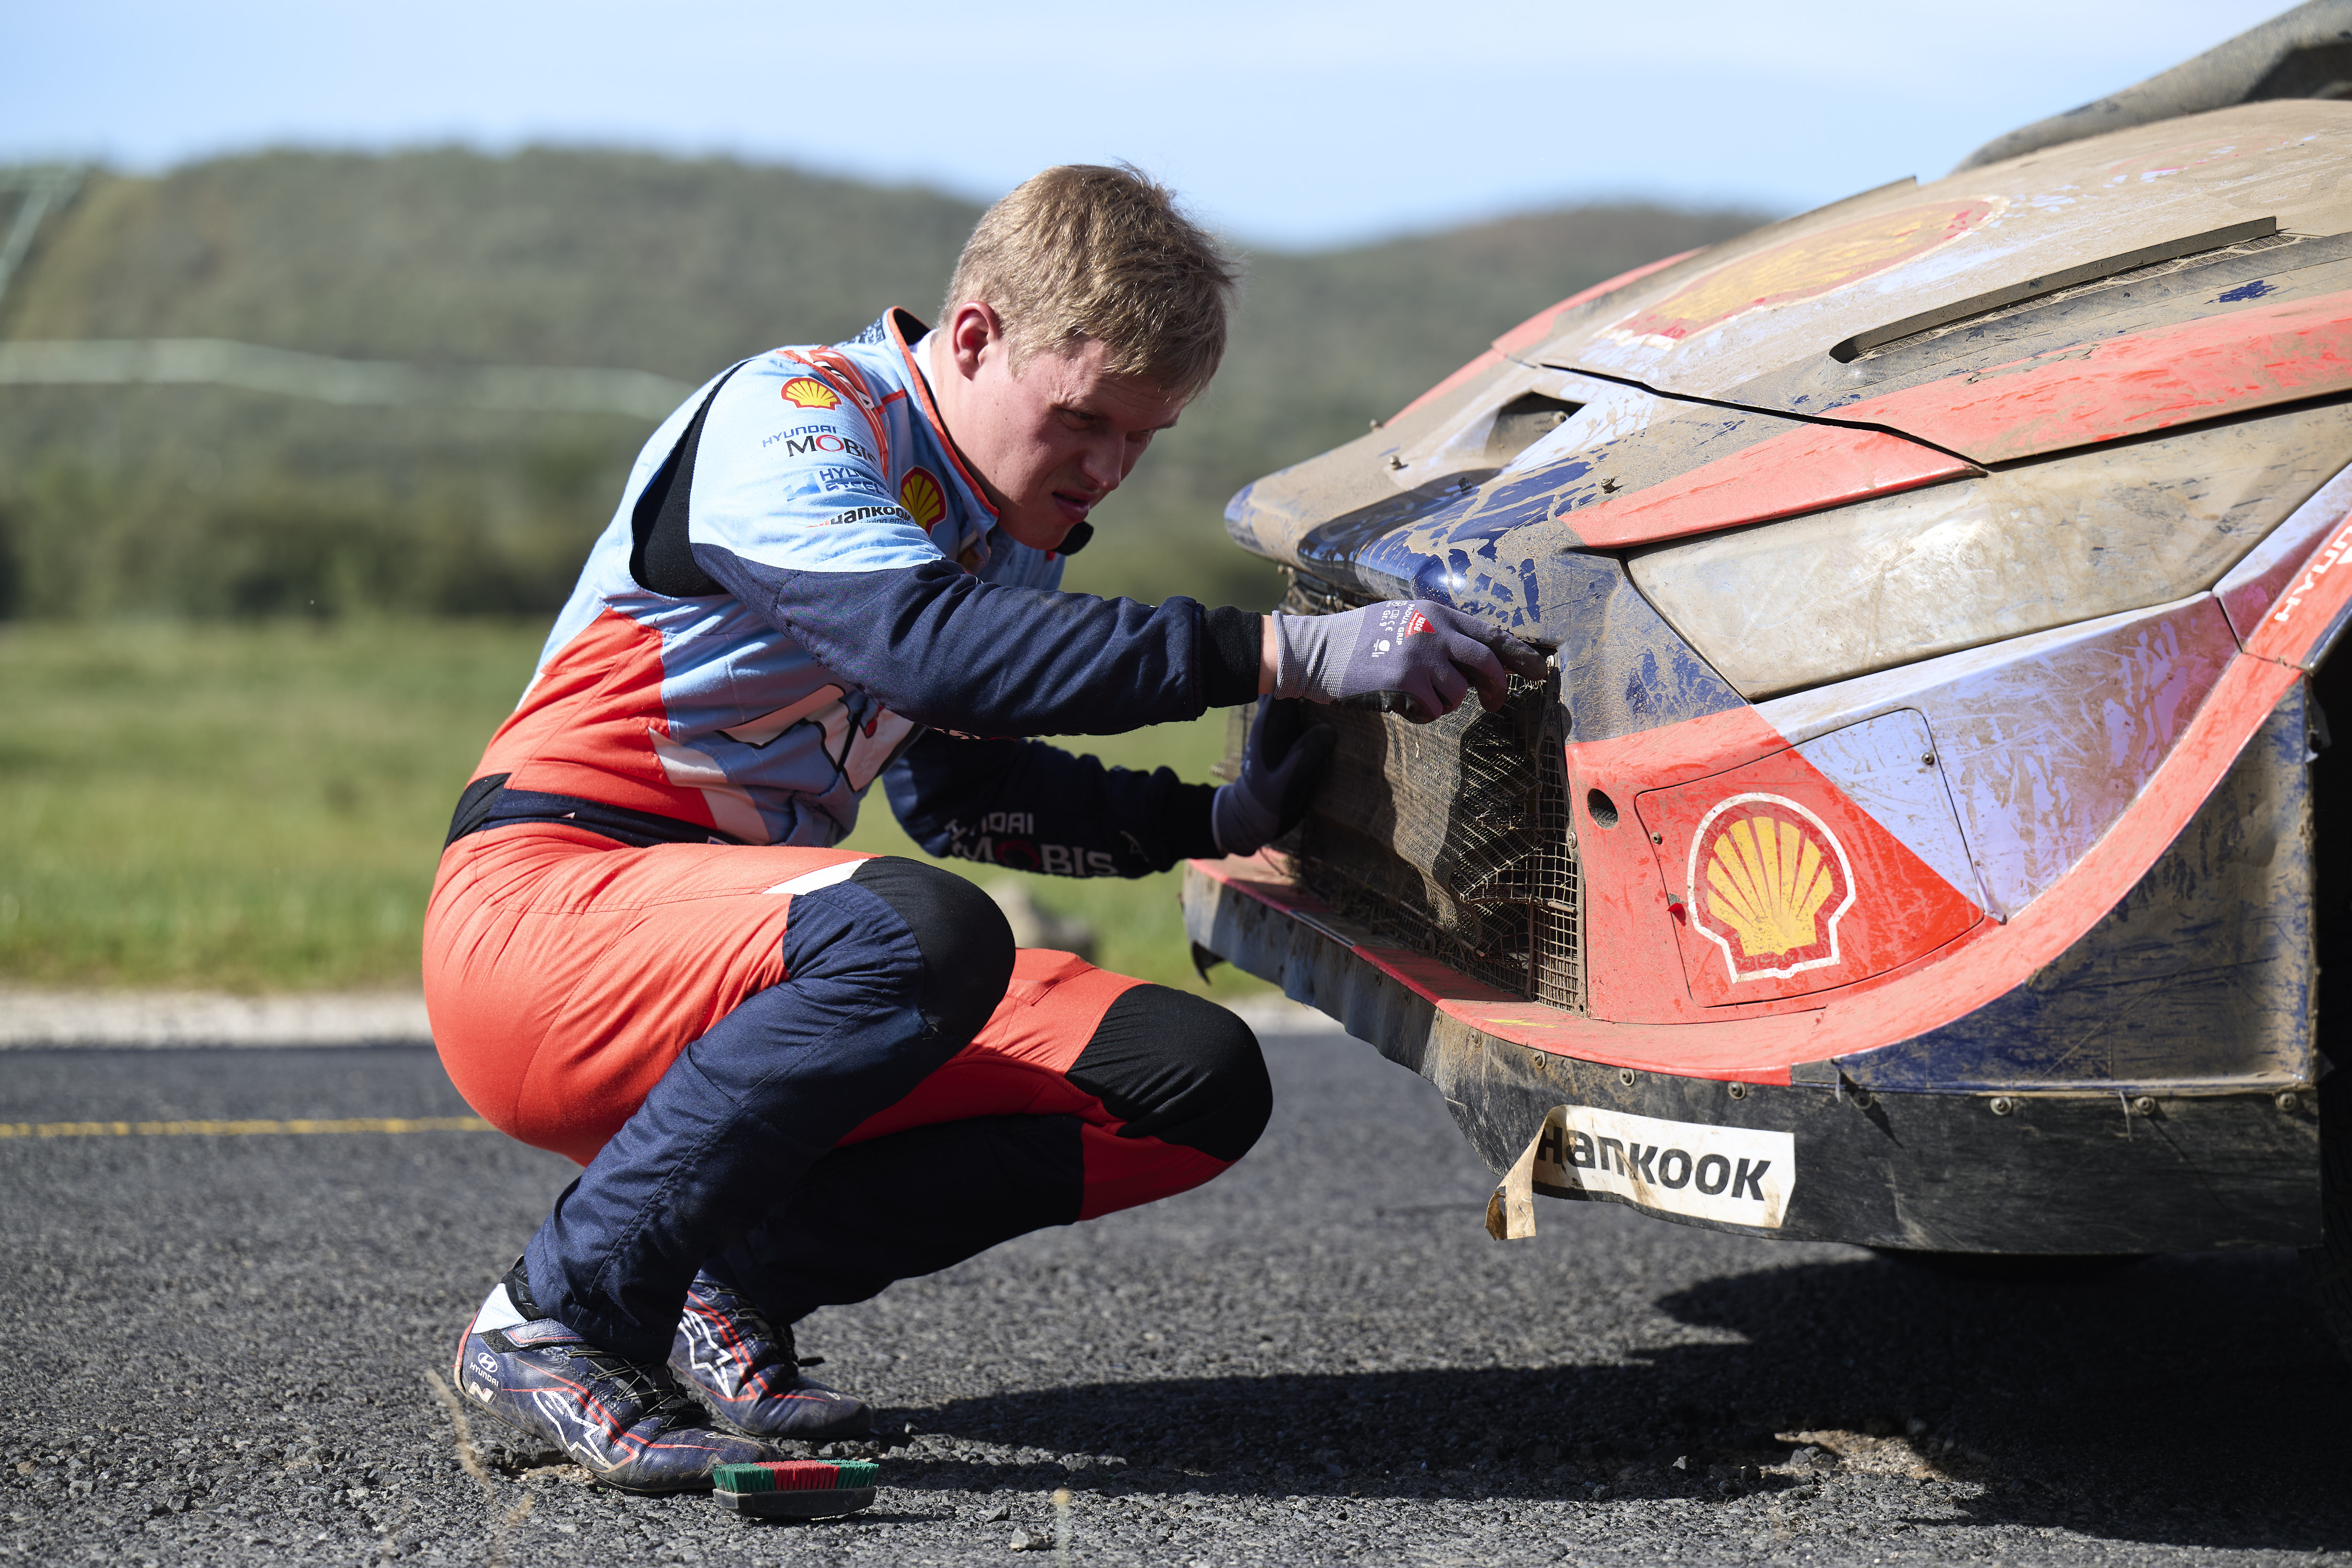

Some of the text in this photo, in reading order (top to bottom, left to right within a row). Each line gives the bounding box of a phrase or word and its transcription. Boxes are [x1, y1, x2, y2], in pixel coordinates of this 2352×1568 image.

[762, 425, 837, 448] HYUNDAI
[1396, 604, 1415, 645] PADUA GRIP
[469, 1362, 499, 1387] HYUNDAI
